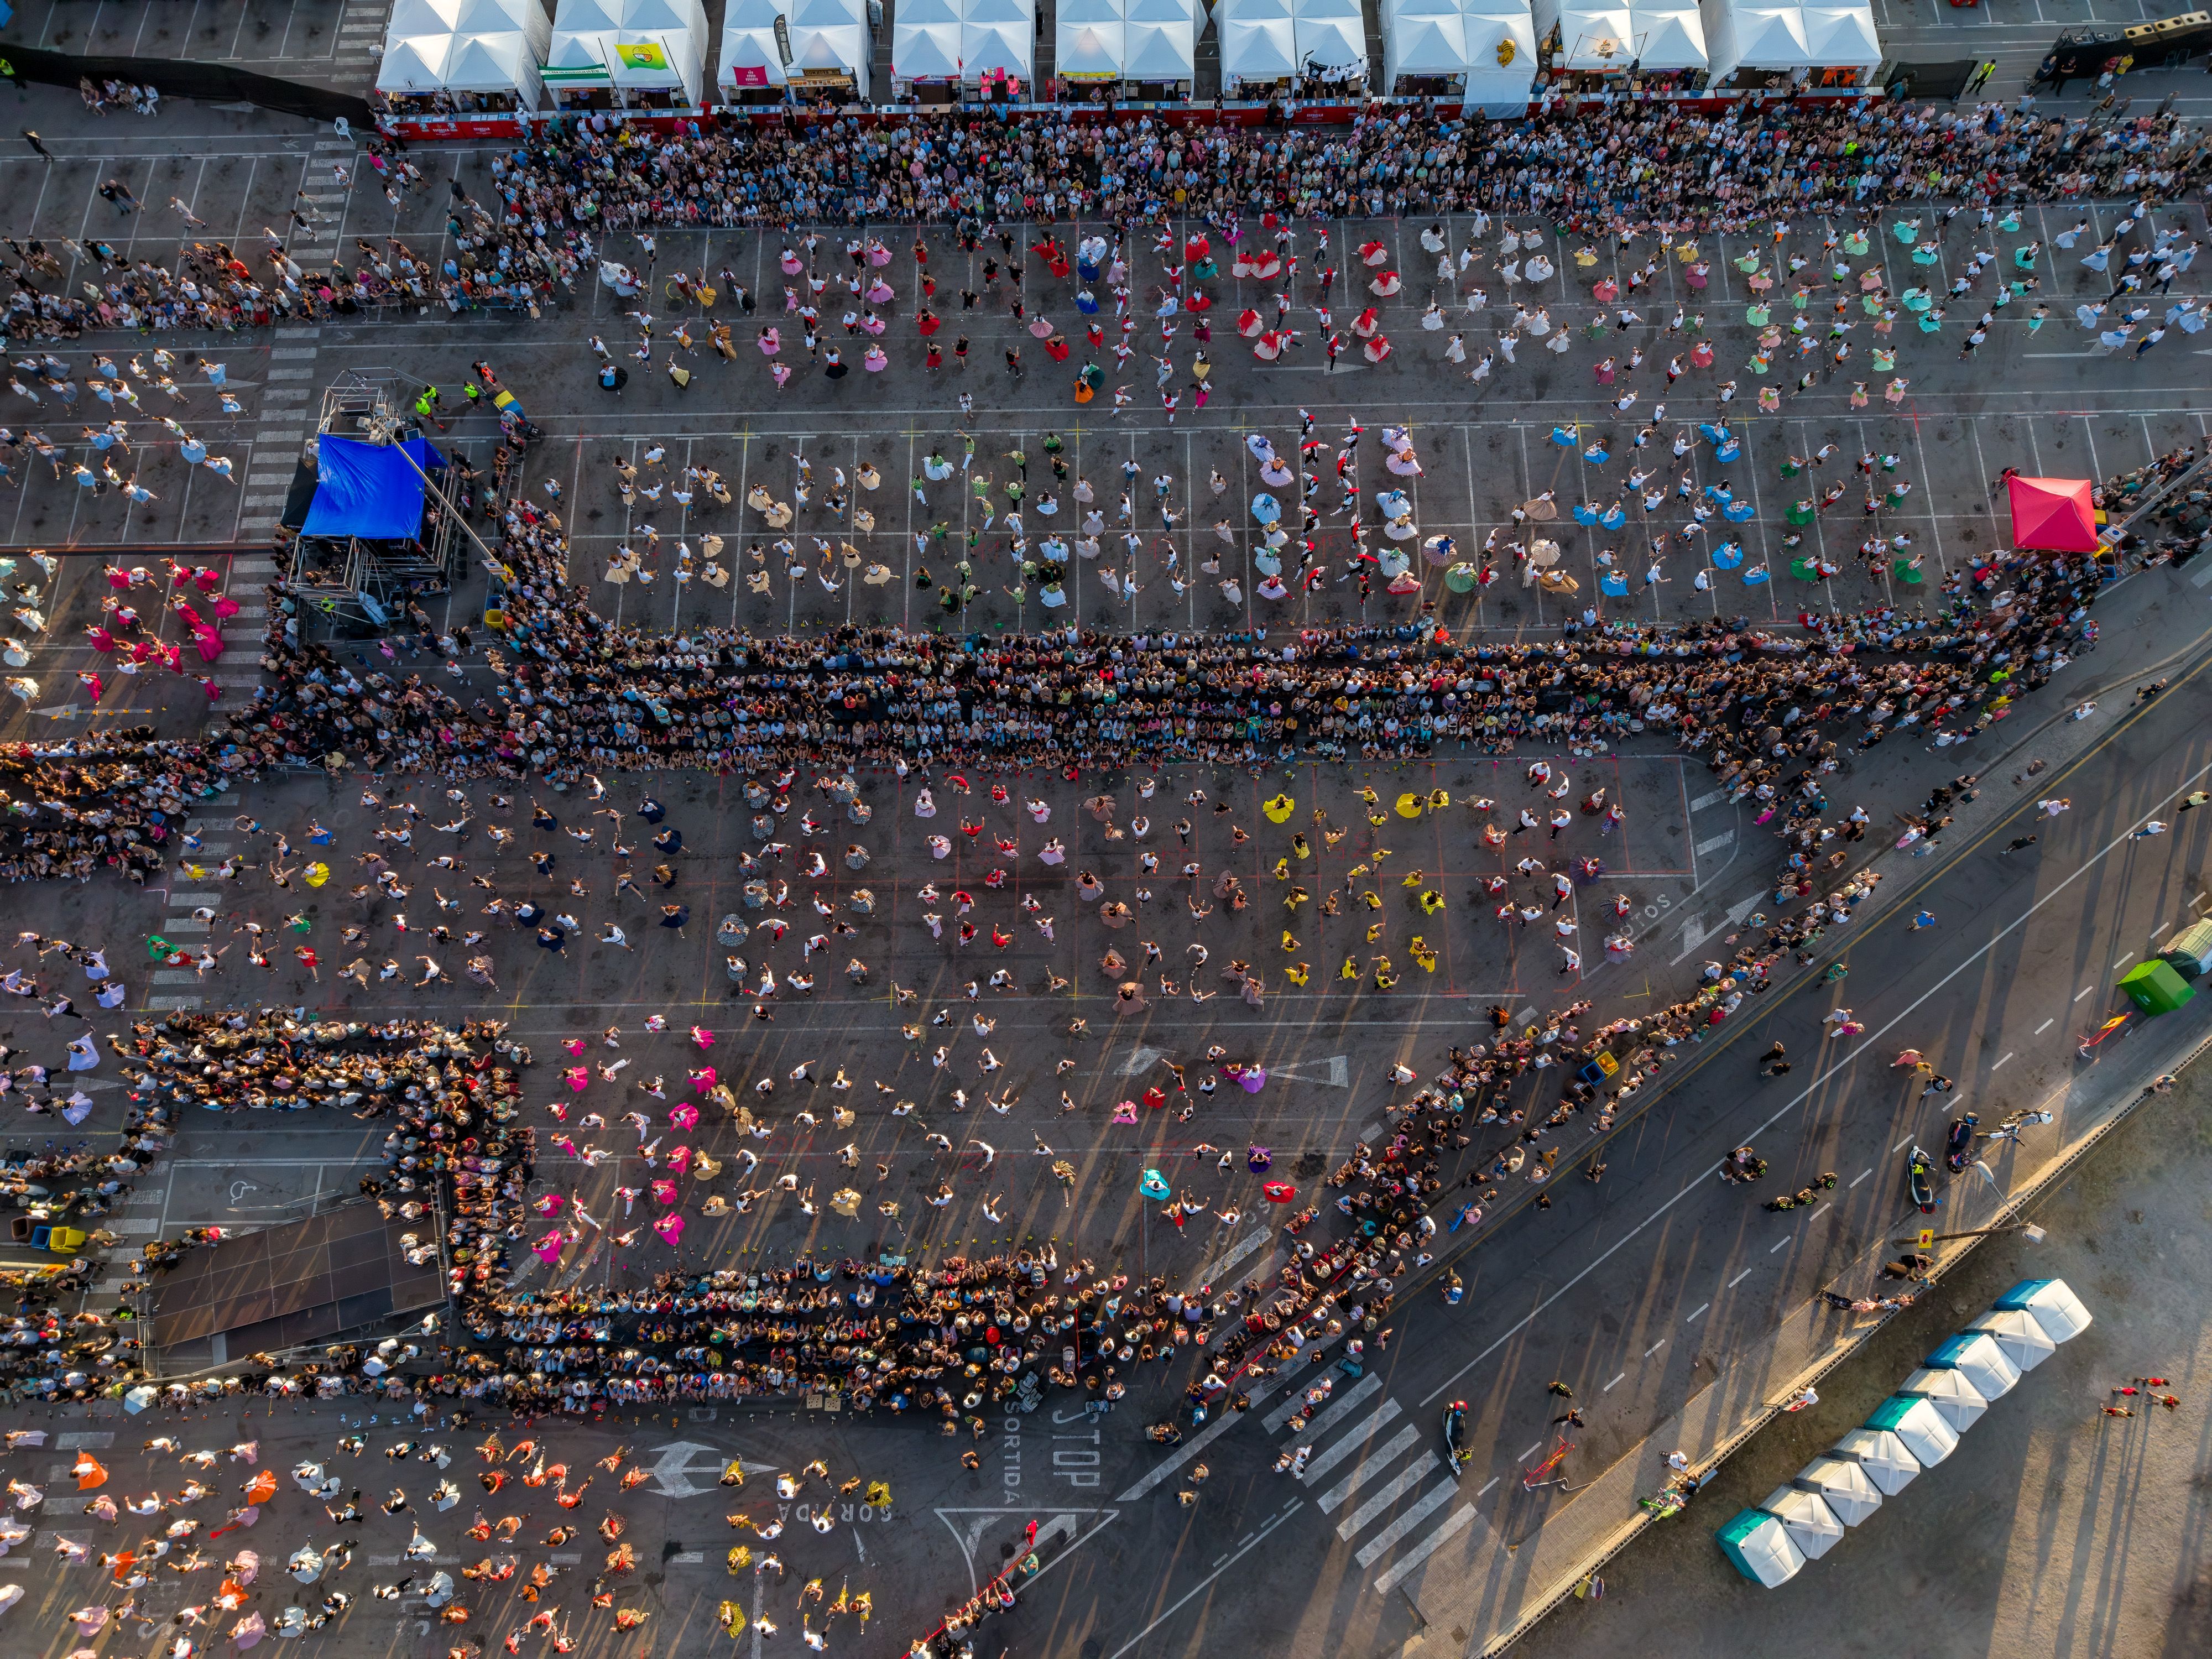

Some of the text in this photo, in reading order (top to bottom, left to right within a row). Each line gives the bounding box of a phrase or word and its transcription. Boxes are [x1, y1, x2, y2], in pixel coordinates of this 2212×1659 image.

[1620, 893, 1672, 937] OTOS
[1004, 1401, 1020, 1504] SORTIDA
[1052, 1409, 1100, 1486] STOP
[778, 1503, 893, 1522] SORIDA
